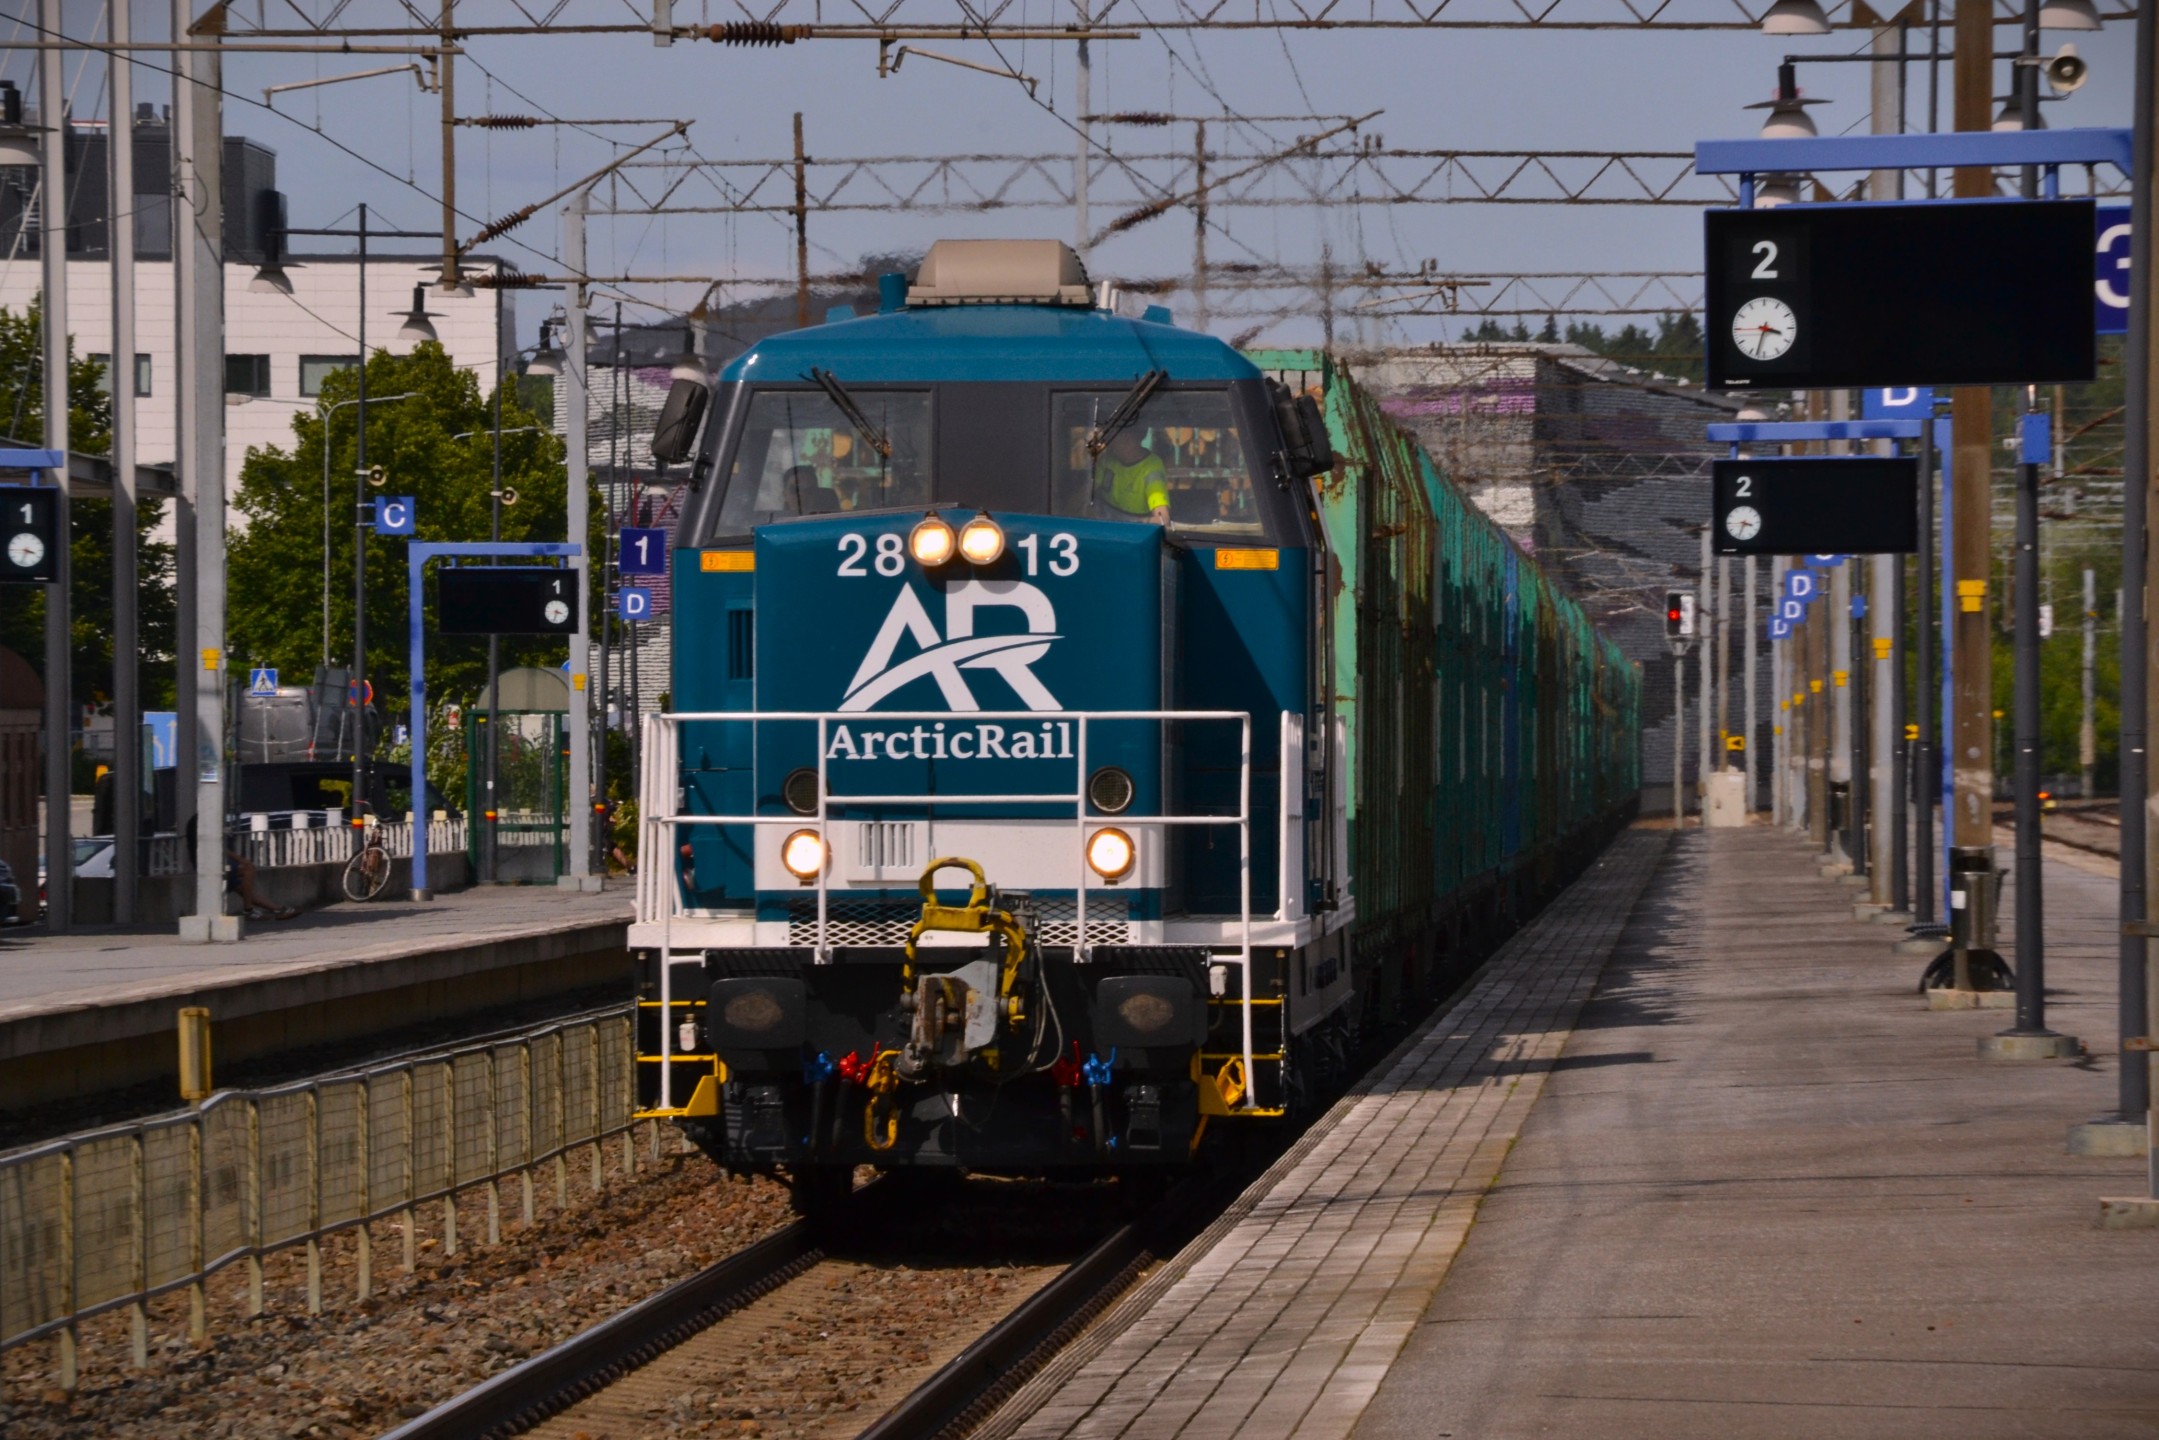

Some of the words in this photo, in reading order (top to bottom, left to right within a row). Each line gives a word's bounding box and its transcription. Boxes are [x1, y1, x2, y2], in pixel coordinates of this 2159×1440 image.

[1751, 240, 1778, 279] 2
[2095, 223, 2132, 309] 3
[1735, 476, 1752, 497] 2
[19, 503, 33, 524] 1
[383, 503, 406, 528] C
[635, 535, 649, 566] 1
[837, 532, 906, 577] 28
[1017, 532, 1080, 577] 13
[552, 579, 562, 595] 1
[1791, 575, 1812, 597] D
[626, 593, 645, 614] D
[1784, 600, 1802, 619] D
[838, 580, 1065, 711] AR
[825, 721, 1075, 760] ArcticRail
